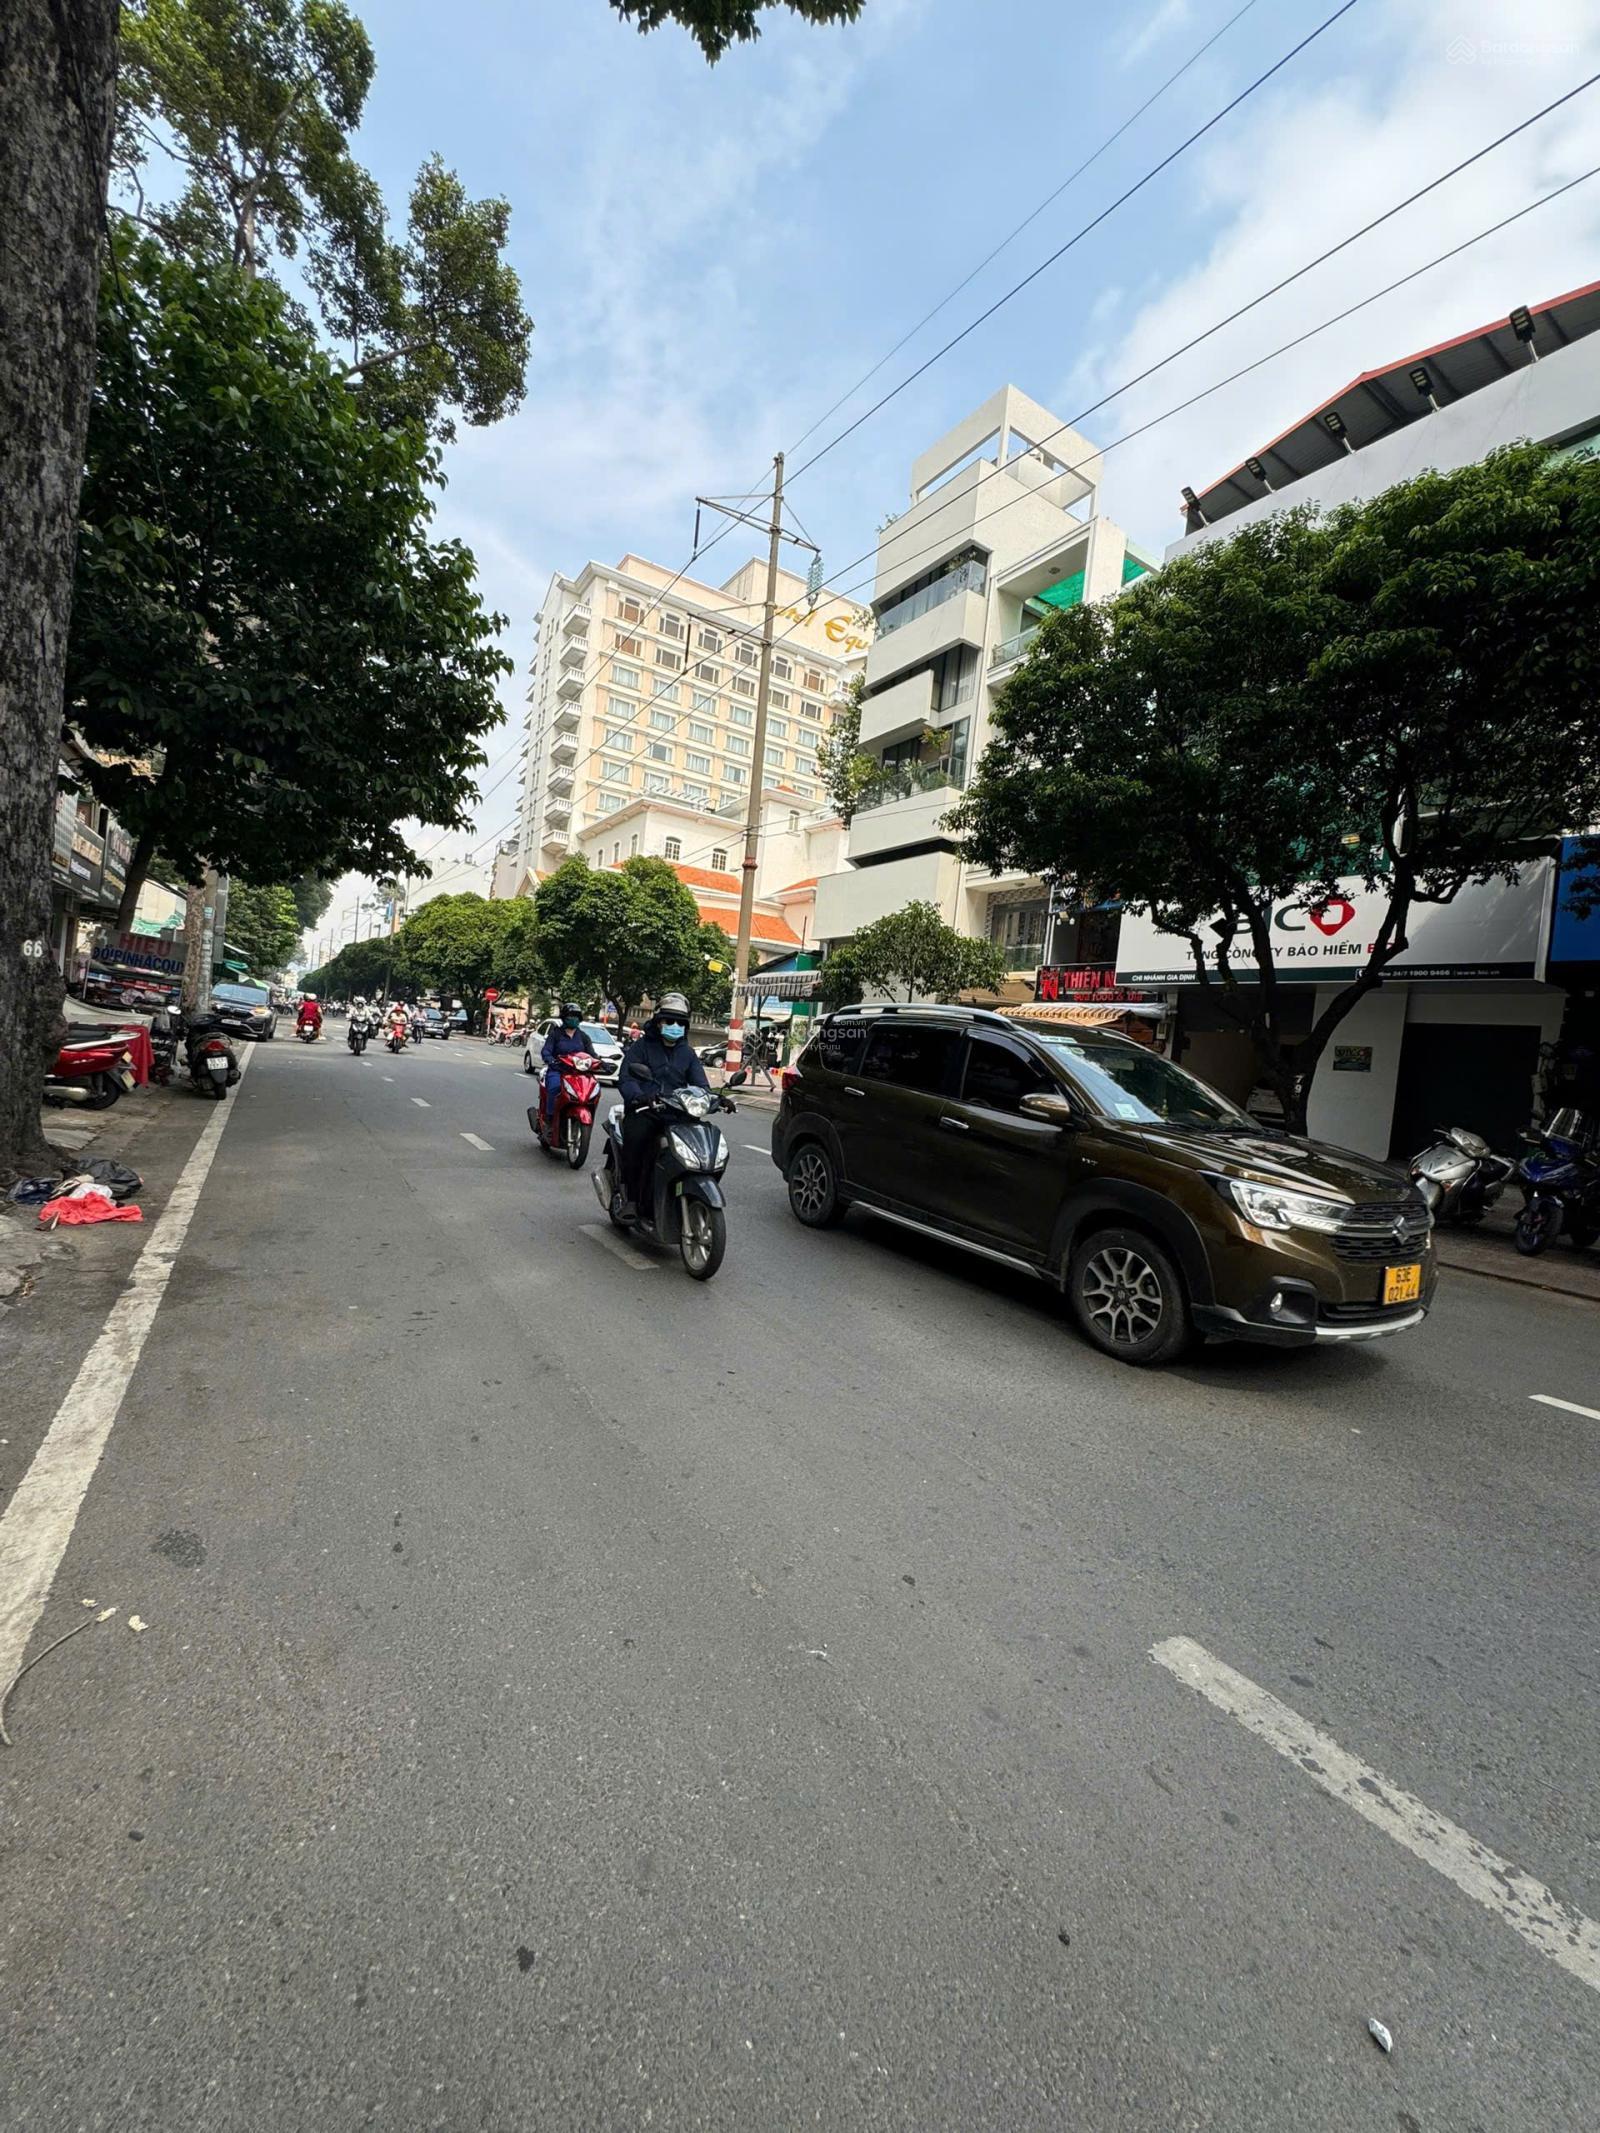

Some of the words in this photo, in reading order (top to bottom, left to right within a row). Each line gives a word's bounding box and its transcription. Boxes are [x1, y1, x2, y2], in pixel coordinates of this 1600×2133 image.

[23, 939, 43, 958] 66
[1187, 950, 1218, 960] TNG
[1288, 943, 1318, 957] BẢO
[1323, 940, 1361, 955] HIỂM
[1064, 966, 1101, 989] THIÊN
[1132, 974, 1143, 982] CHI
[1144, 973, 1166, 981] NHÁNH
